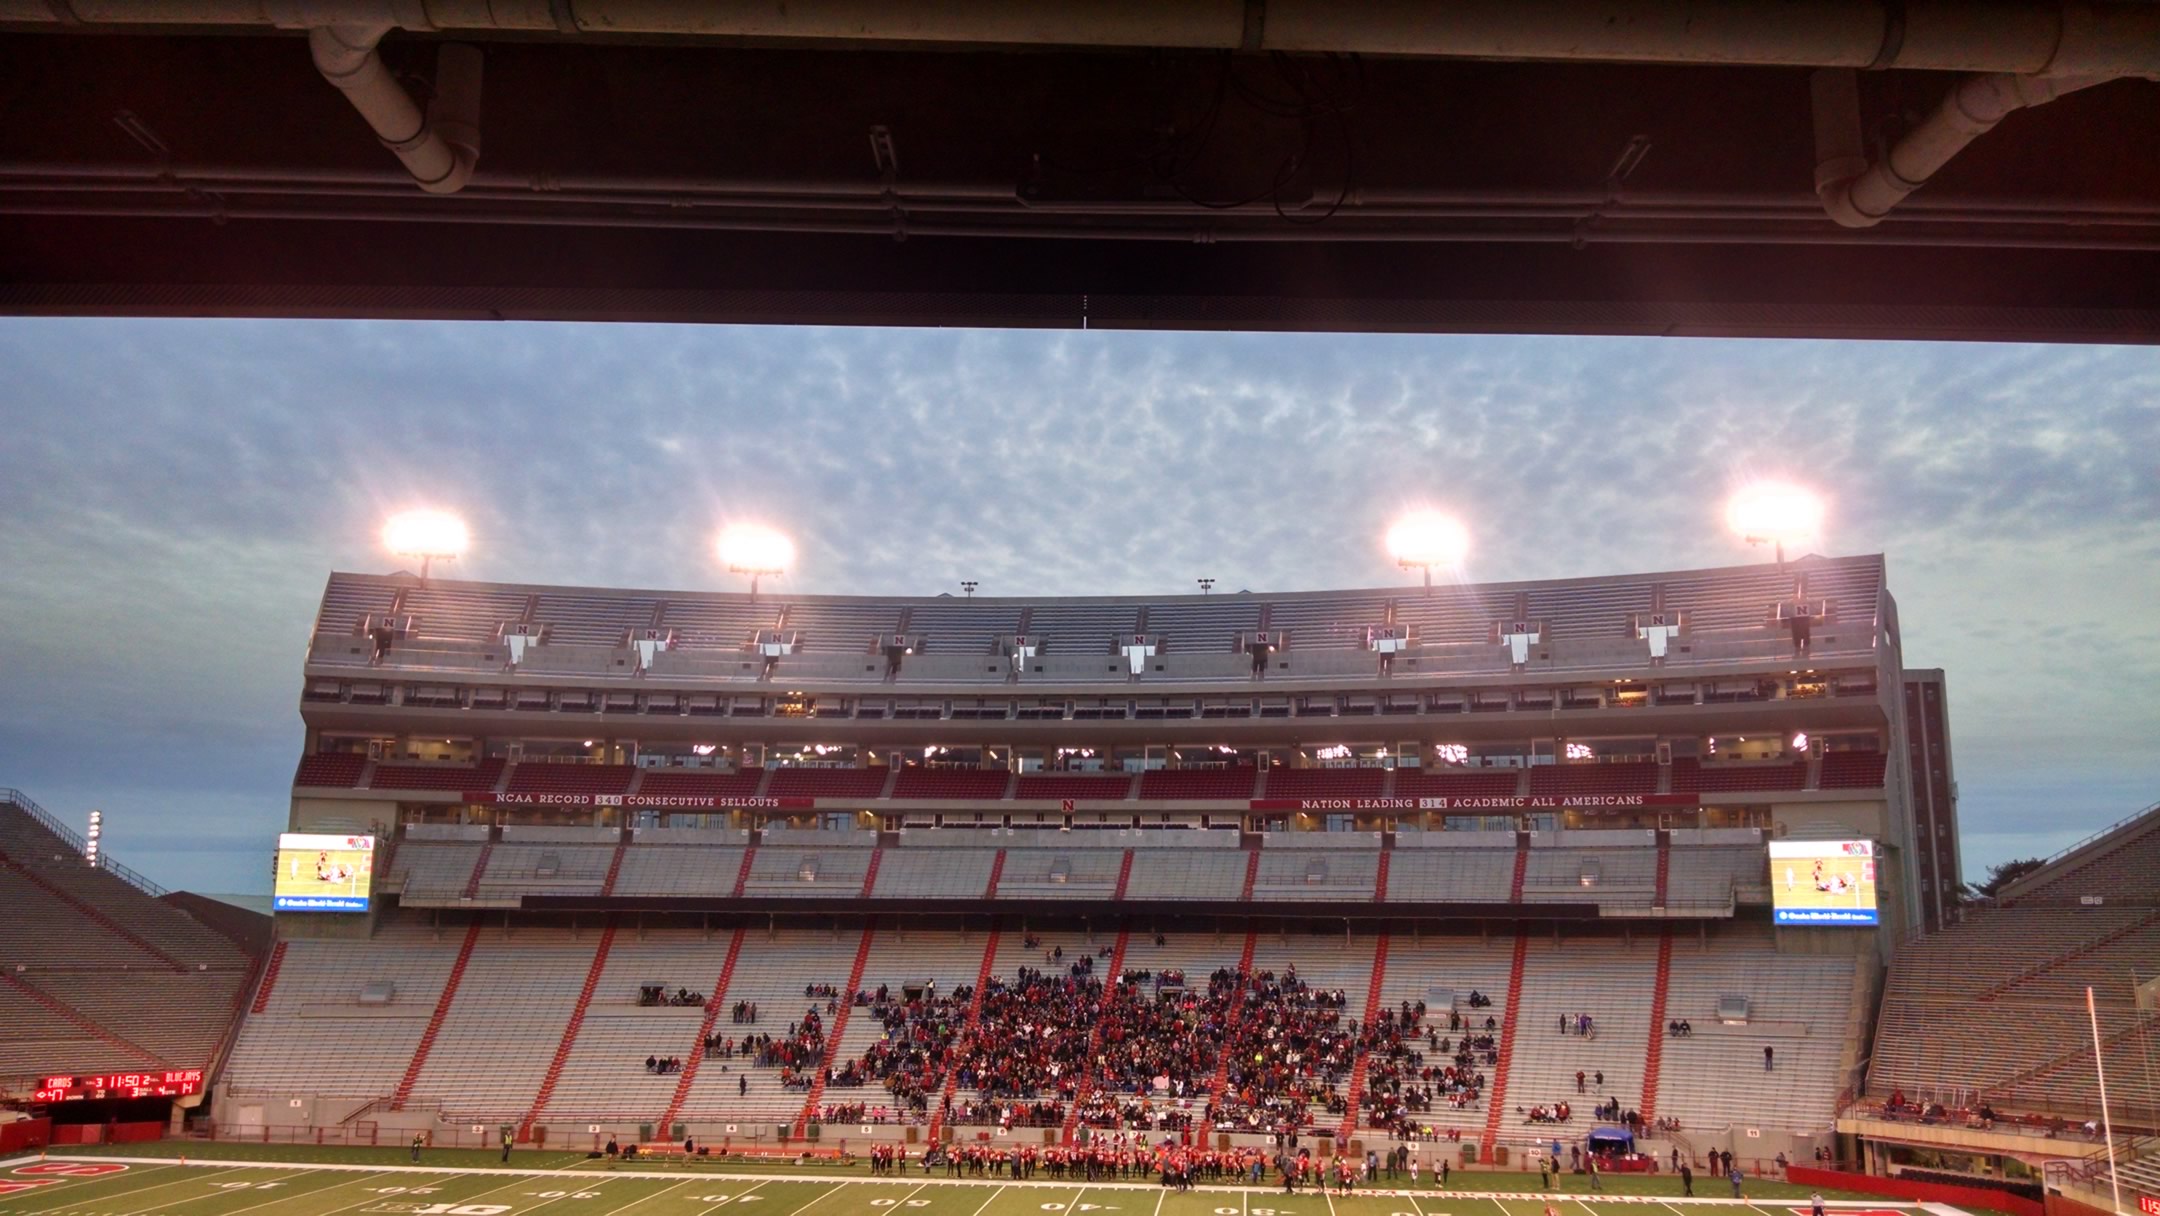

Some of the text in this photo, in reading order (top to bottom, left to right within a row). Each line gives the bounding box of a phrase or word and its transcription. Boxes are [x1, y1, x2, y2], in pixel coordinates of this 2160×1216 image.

[384, 618, 395, 627] N
[1653, 616, 1663, 625] N
[518, 625, 528, 634] N
[1515, 624, 1525, 633] N
[648, 630, 657, 639] N
[773, 634, 782, 642] N
[1258, 633, 1267, 642] N
[1384, 630, 1393, 638] N
[895, 636, 904, 645] N
[1016, 637, 1025, 646] N
[1135, 636, 1144, 645] N
[496, 793, 533, 803] NCAA
[539, 795, 590, 804] RECORD
[627, 796, 714, 806] CONSECUTIVE
[720, 797, 779, 807] SELLOUTS
[1302, 799, 1351, 809] NATION
[1357, 799, 1413, 808] LEADING
[1453, 798, 1525, 808] ACADEMIC
[1532, 797, 1556, 807] ALL
[1562, 796, 1644, 806] AMERICANS
[1062, 799, 1075, 811] N
[48, 1077, 73, 1089] CARDS
[96, 1077, 104, 1088] 3
[110, 1074, 140, 1088] 11:50
[48, 1089, 63, 1101] 47
[131, 1087, 139, 1097] 3
[703, 1194, 764, 1203] 40
[1040, 1202, 1102, 1211] 40
